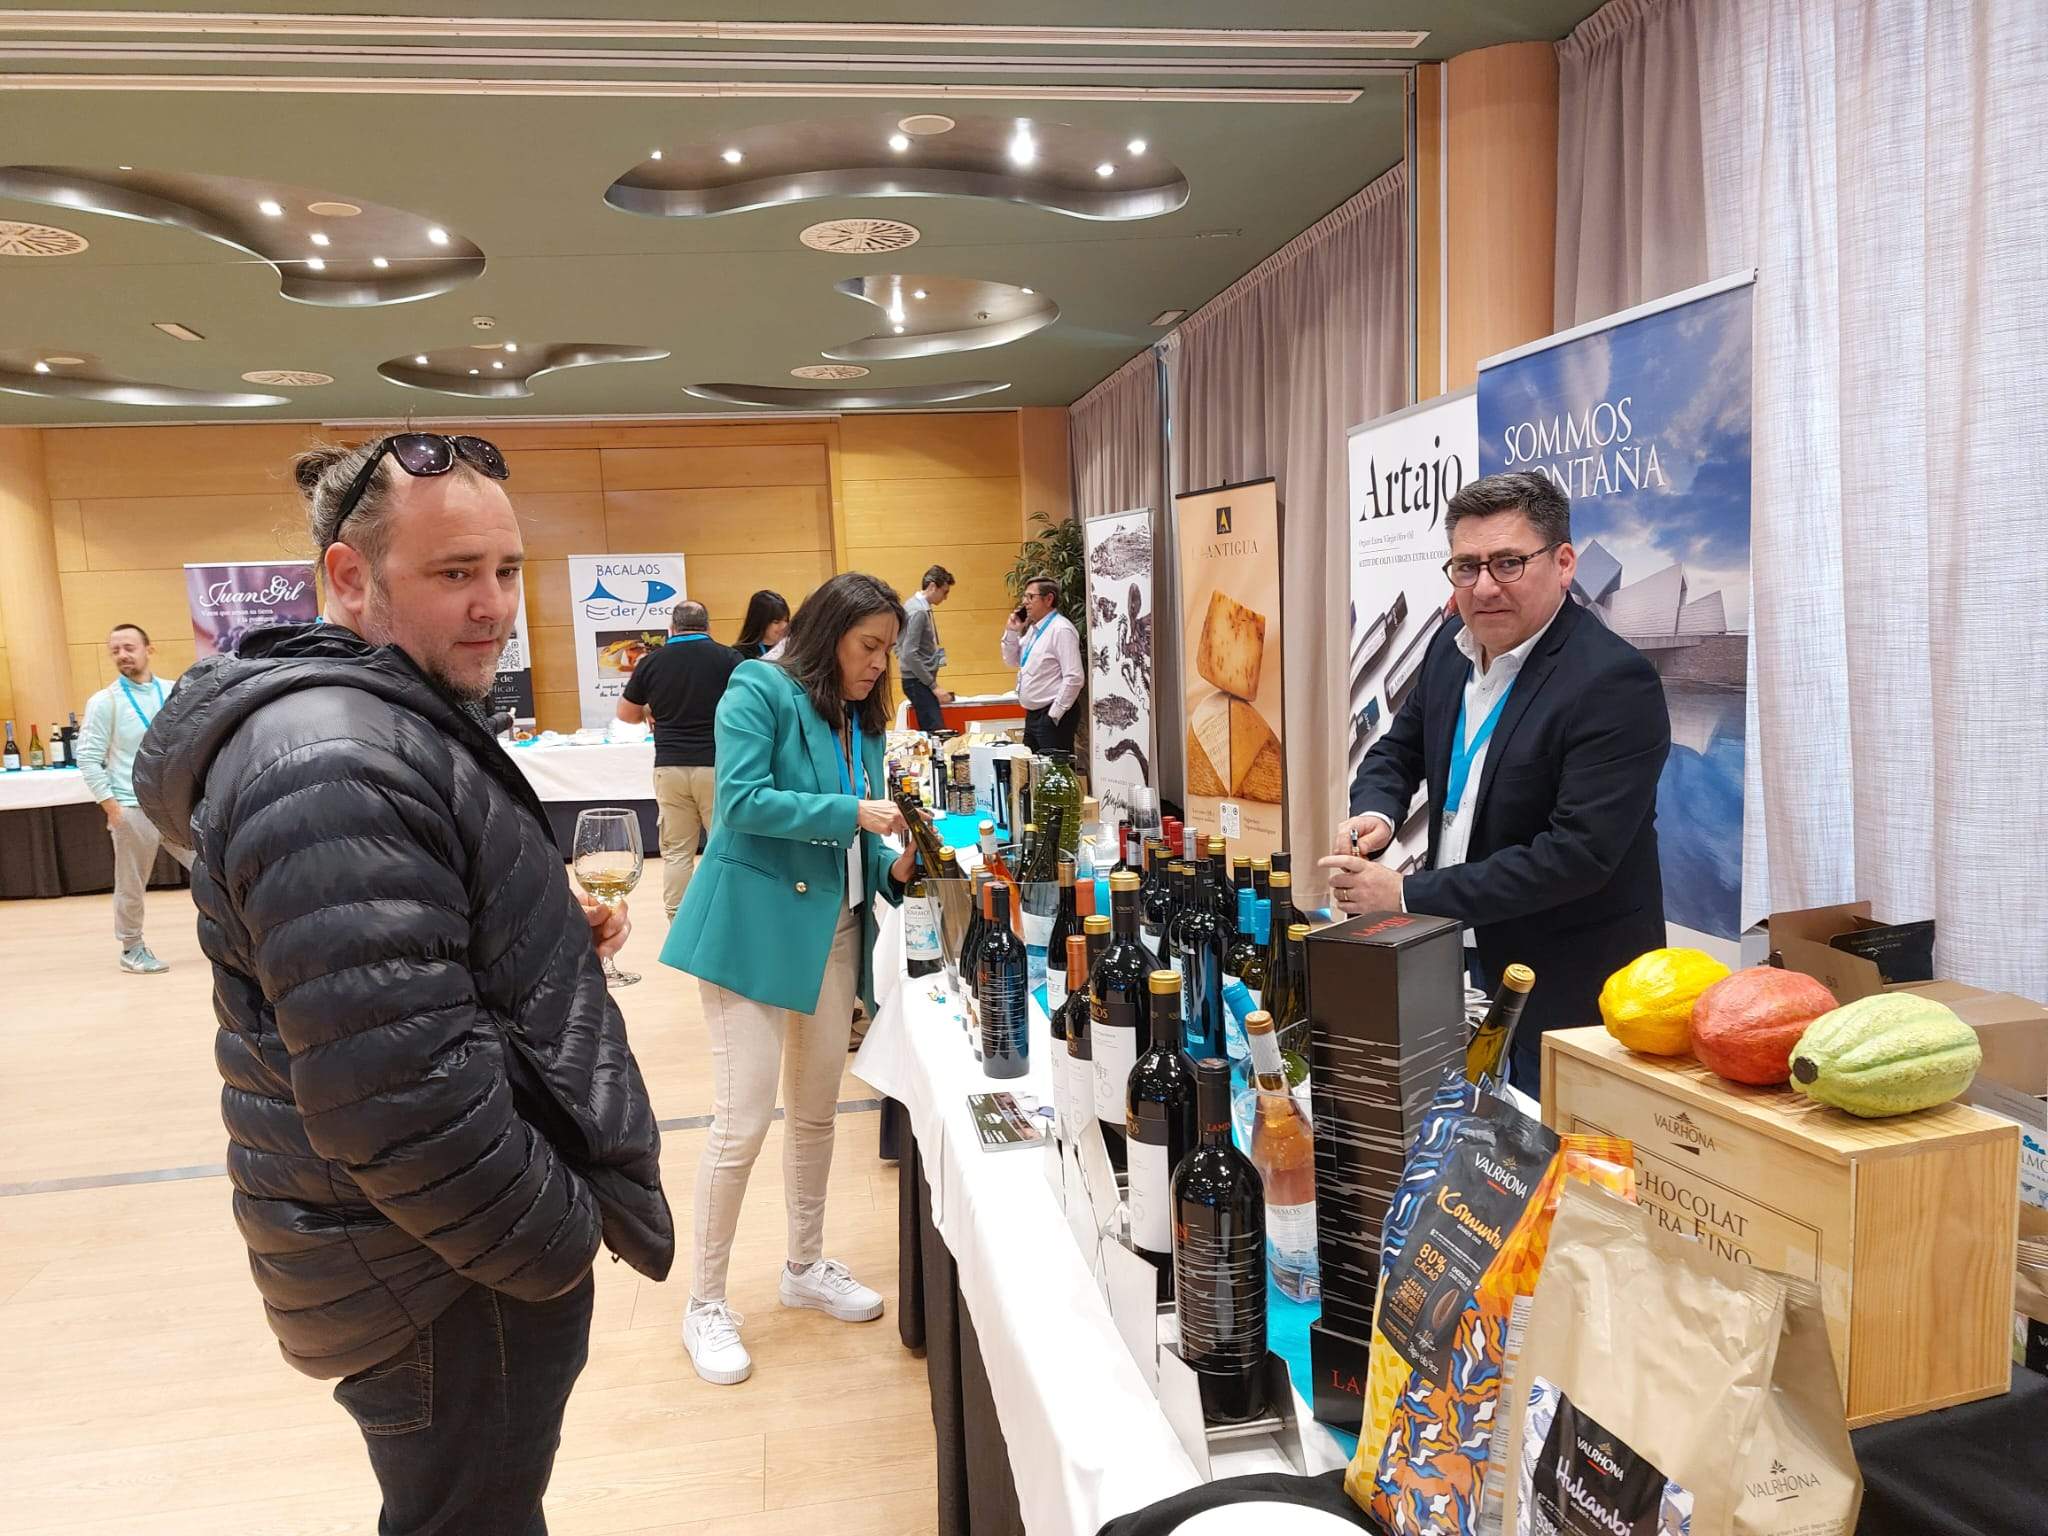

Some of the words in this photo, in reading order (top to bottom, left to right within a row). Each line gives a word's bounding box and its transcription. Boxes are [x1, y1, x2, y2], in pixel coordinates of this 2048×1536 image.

[1504, 397, 1633, 466] SOMMOS
[1359, 435, 1462, 532] Artajo
[596, 564, 661, 577] BACALAOS
[500, 675, 514, 683] de
[1654, 1113, 1716, 1151] VALRHONA
[1474, 1152, 1529, 1200] VALRHONA
[1634, 1156, 1749, 1238] CHOCOLAT
[1414, 1257, 1439, 1281] CACAO
[1420, 1243, 1447, 1273] 80%
[1577, 1436, 1624, 1481] VALRHONA
[1556, 1456, 1634, 1536] Hukambi
[1745, 1473, 1821, 1498] VALRHONA
